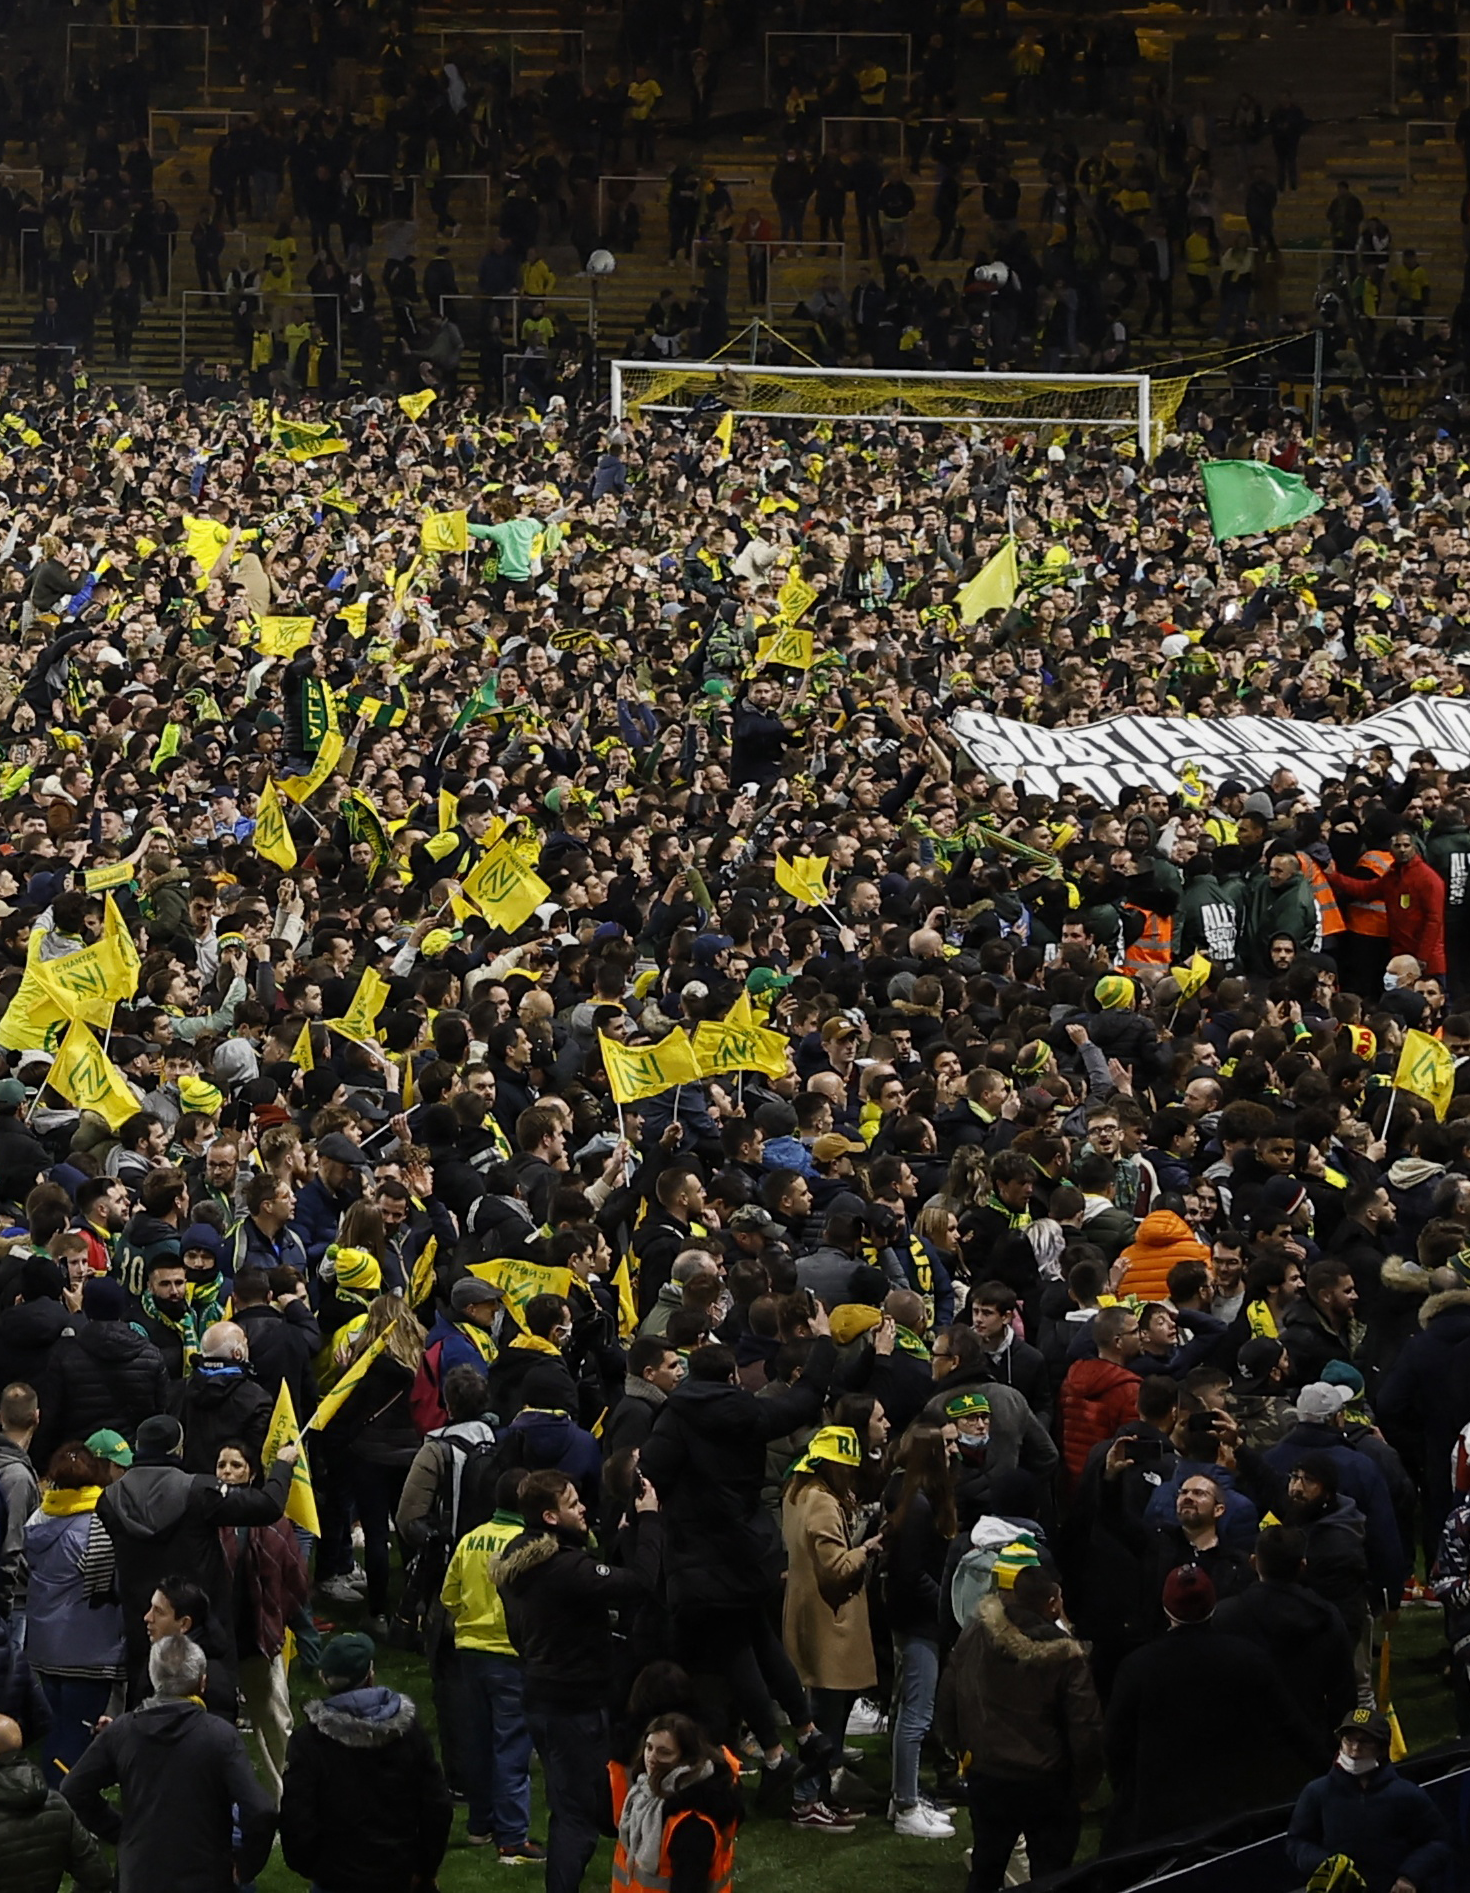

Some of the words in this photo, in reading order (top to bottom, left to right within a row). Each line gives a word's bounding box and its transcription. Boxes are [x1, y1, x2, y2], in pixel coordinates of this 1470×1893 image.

[51, 961, 64, 973] FC
[64, 951, 99, 969] NANTES
[466, 1535, 508, 1553] NANT
